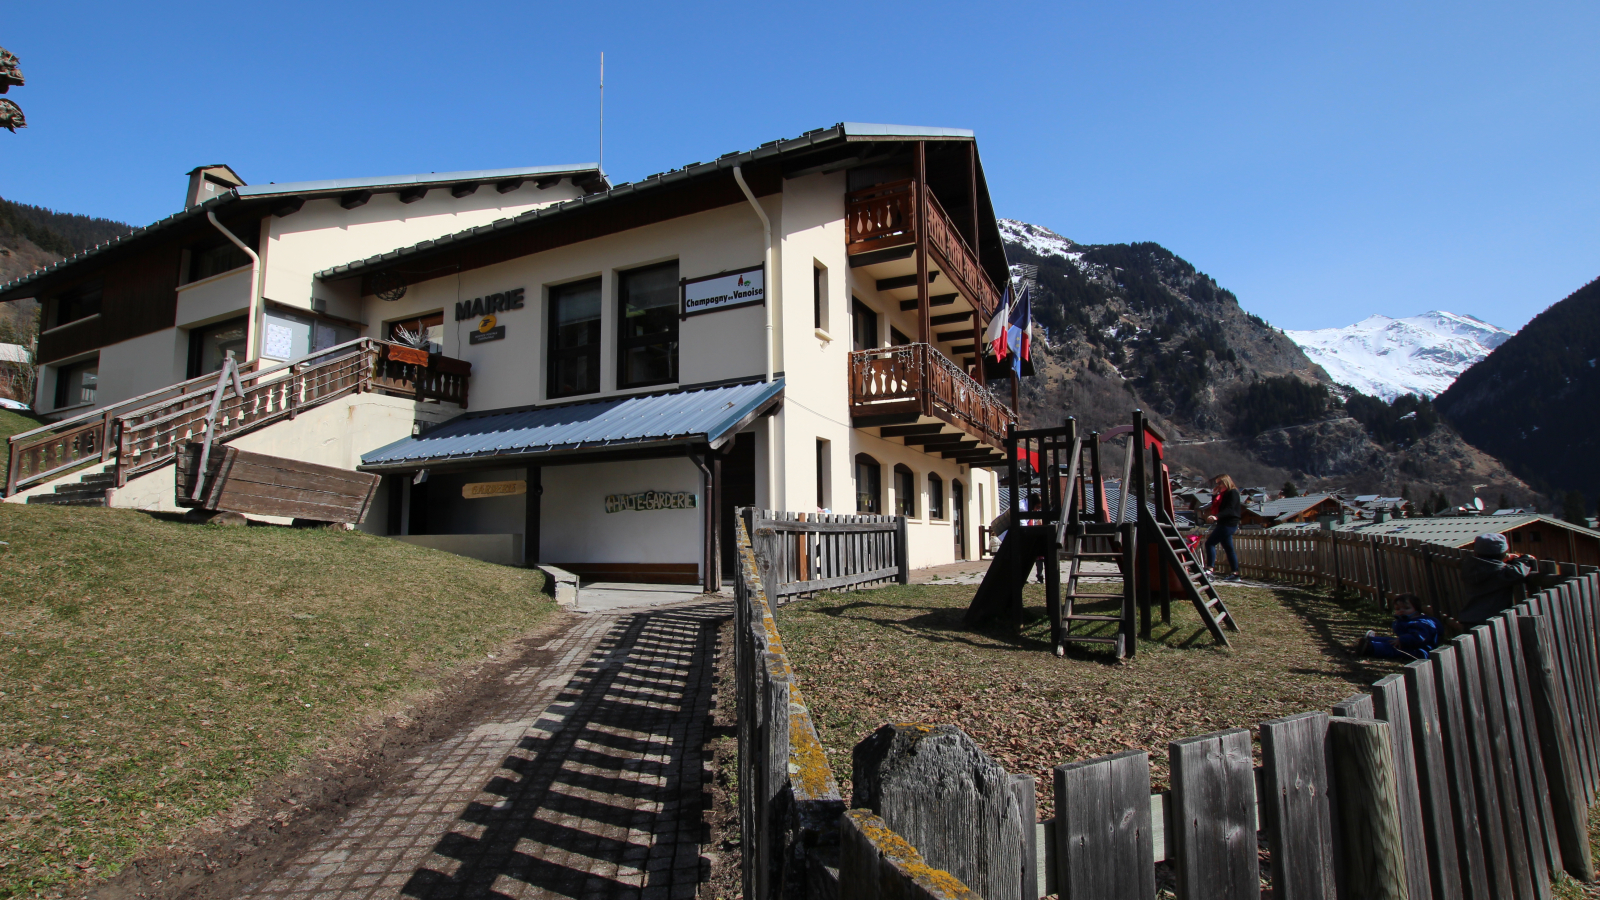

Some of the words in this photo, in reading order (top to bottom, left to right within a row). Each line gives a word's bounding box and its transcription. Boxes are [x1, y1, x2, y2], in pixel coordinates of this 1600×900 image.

[455, 288, 524, 321] MAIRIE
[686, 295, 728, 308] Champagny
[733, 287, 763, 300] Vanoise
[612, 491, 694, 511] HALTE-GARDERIE
